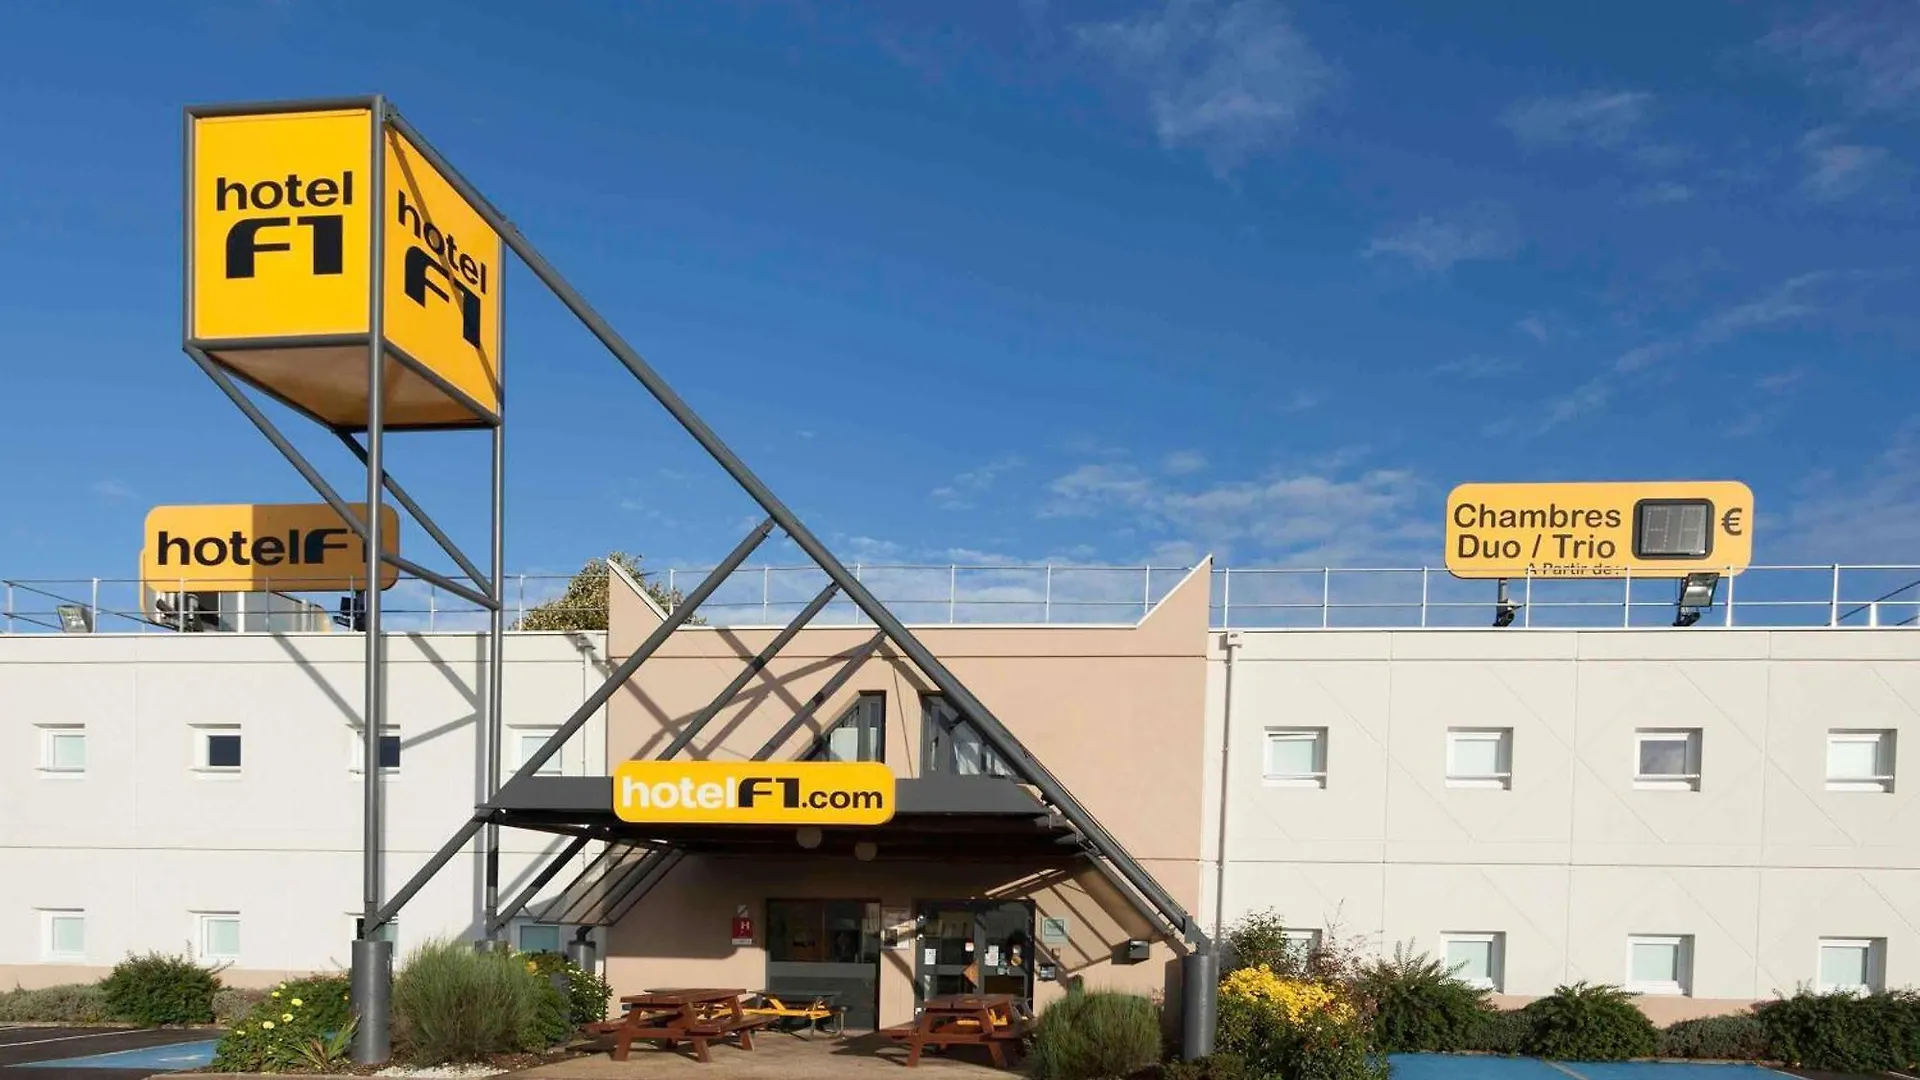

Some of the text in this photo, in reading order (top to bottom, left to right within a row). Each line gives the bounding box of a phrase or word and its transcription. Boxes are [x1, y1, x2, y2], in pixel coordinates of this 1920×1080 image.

[216, 171, 353, 211] hotel
[226, 214, 343, 279] F1
[398, 189, 487, 294] hotel
[404, 245, 481, 350] F1
[1454, 503, 1743, 536] Chambres €
[157, 528, 382, 566] hotelF
[1458, 534, 1521, 559] Duo
[1552, 534, 1616, 559] Trio
[1543, 562, 1588, 575] Partir
[622, 776, 884, 809] hotelF1.com
